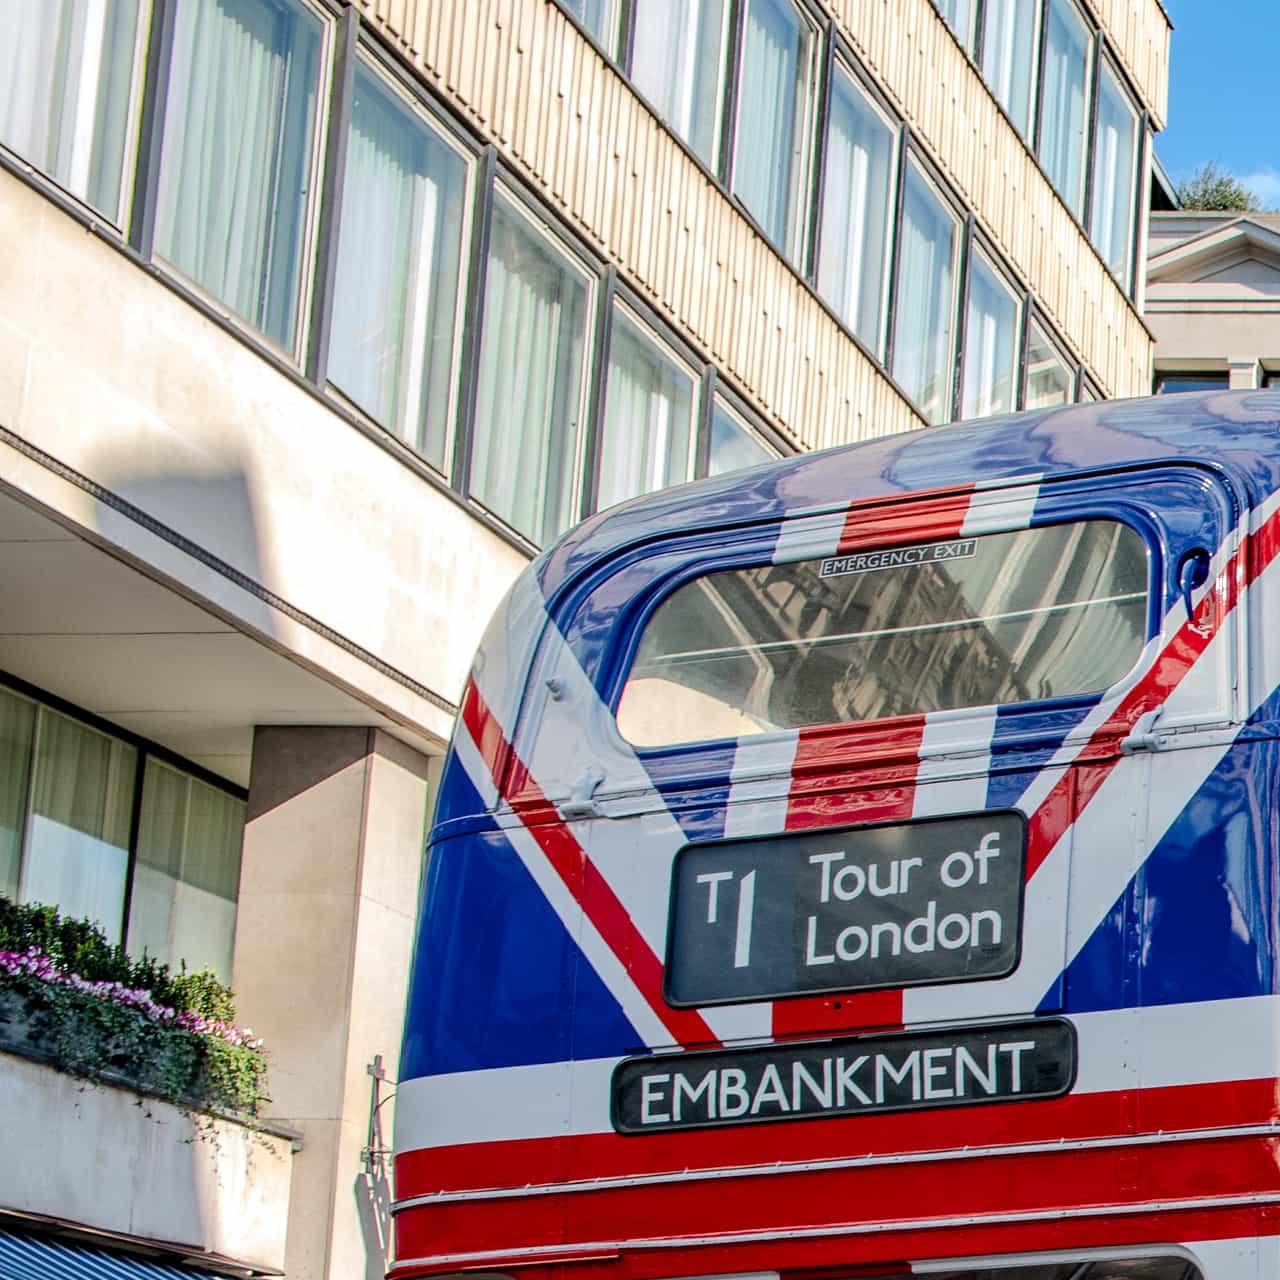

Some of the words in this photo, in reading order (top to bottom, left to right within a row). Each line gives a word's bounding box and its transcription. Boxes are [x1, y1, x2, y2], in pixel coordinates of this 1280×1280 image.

[823, 548, 929, 575] EMERGENCY
[933, 542, 973, 558] EXIT
[809, 851, 923, 904] Tour
[940, 832, 1001, 888] of
[696, 869, 757, 969] T1
[805, 901, 1002, 967] London
[640, 1040, 1036, 1125] EMBANKMENT
